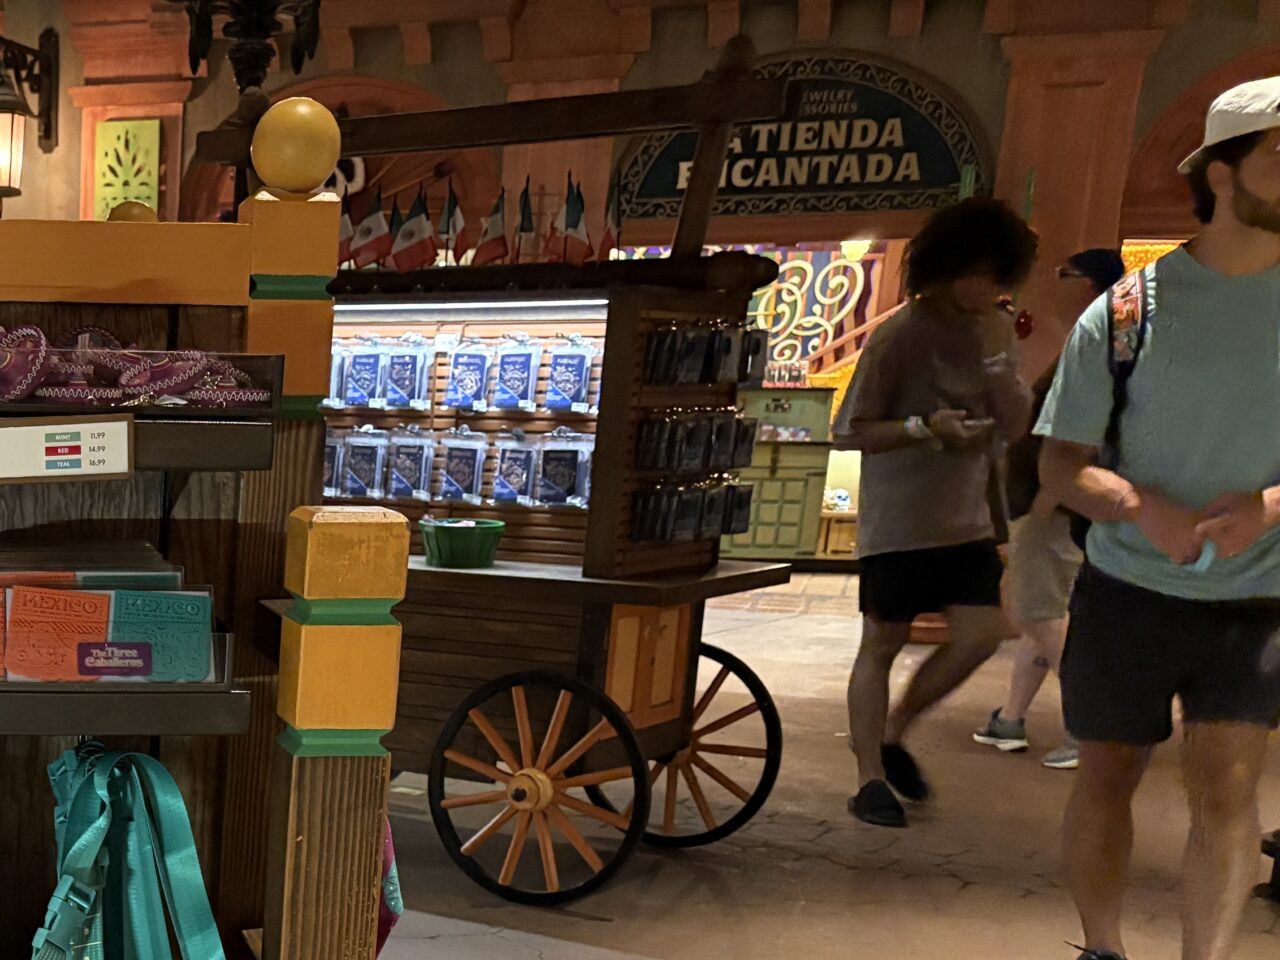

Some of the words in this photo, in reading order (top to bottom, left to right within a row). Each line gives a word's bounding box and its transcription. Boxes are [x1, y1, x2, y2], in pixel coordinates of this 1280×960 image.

[750, 117, 905, 153] TIENDA
[89, 459, 106, 467] 16.99
[22, 593, 98, 614] MEXICO
[105, 646, 139, 658] Three
[84, 656, 144, 668] Caballeros
